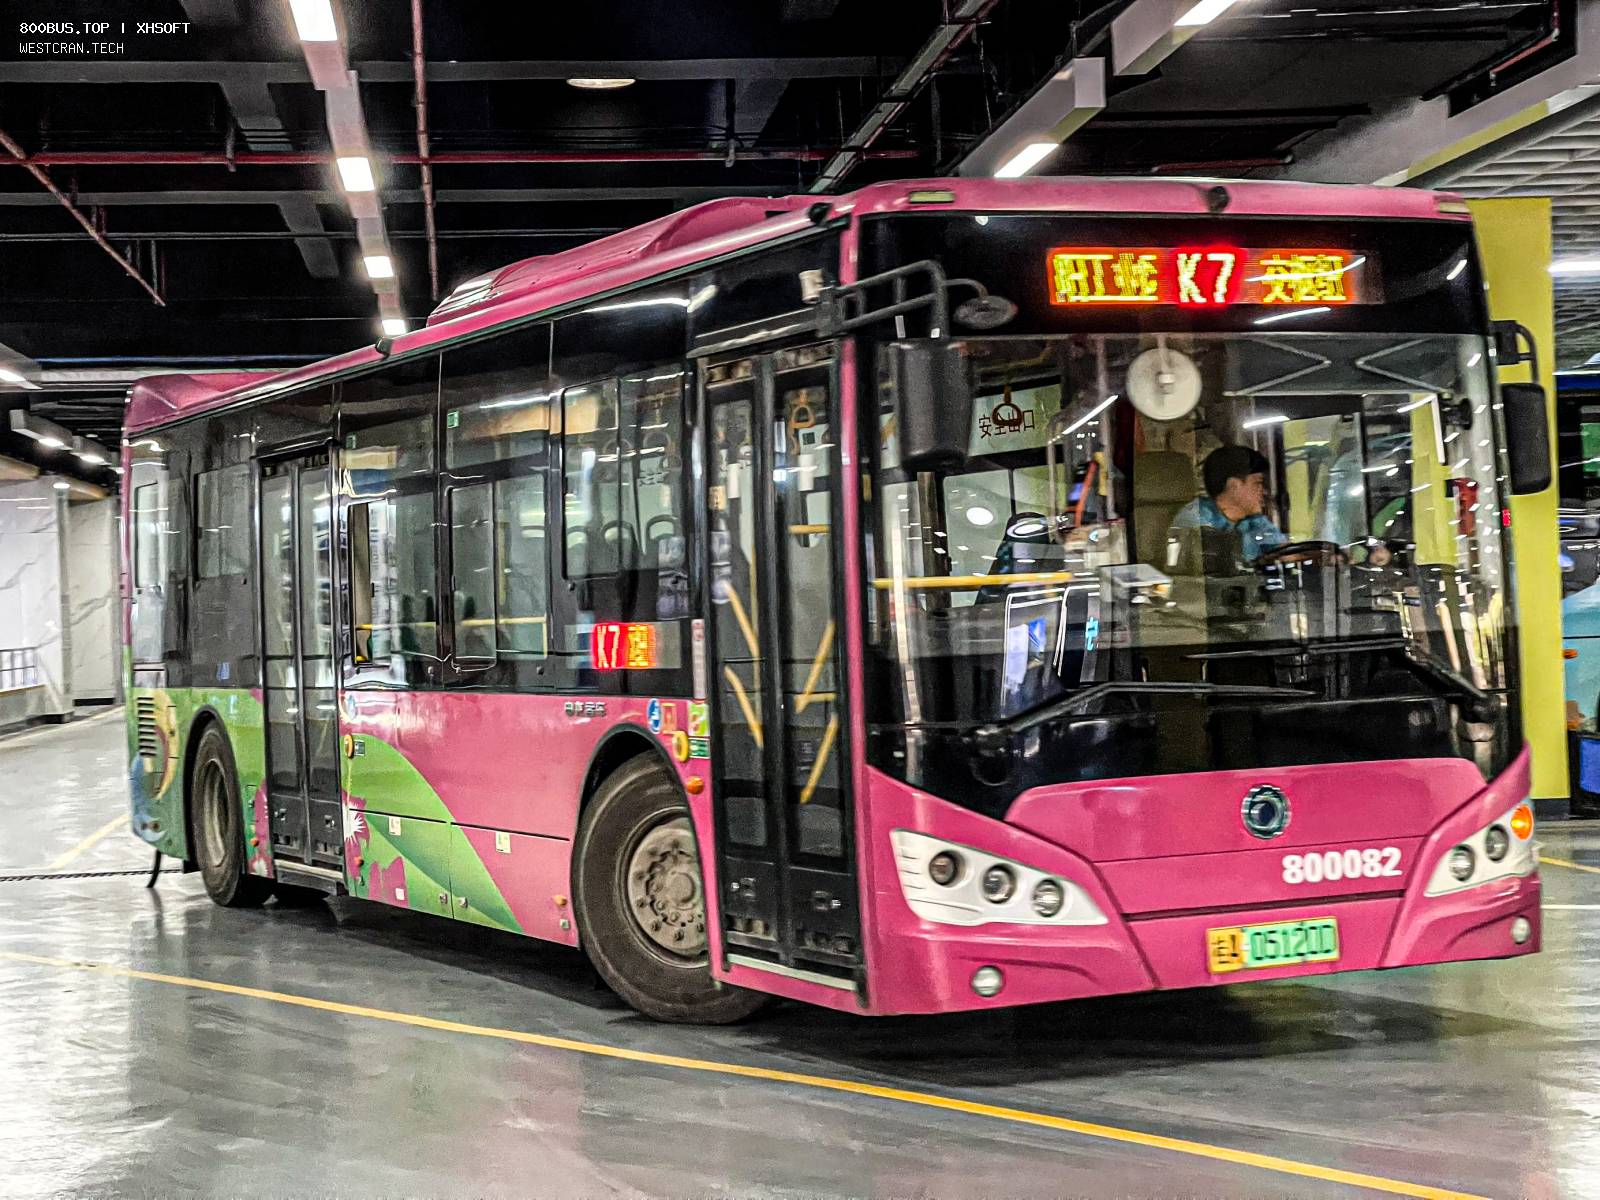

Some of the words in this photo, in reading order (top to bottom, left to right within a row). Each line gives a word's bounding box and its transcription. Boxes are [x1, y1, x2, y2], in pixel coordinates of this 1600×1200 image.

[1176, 253, 1237, 304] K7
[596, 624, 620, 668] K7
[1282, 847, 1403, 884] 800082
